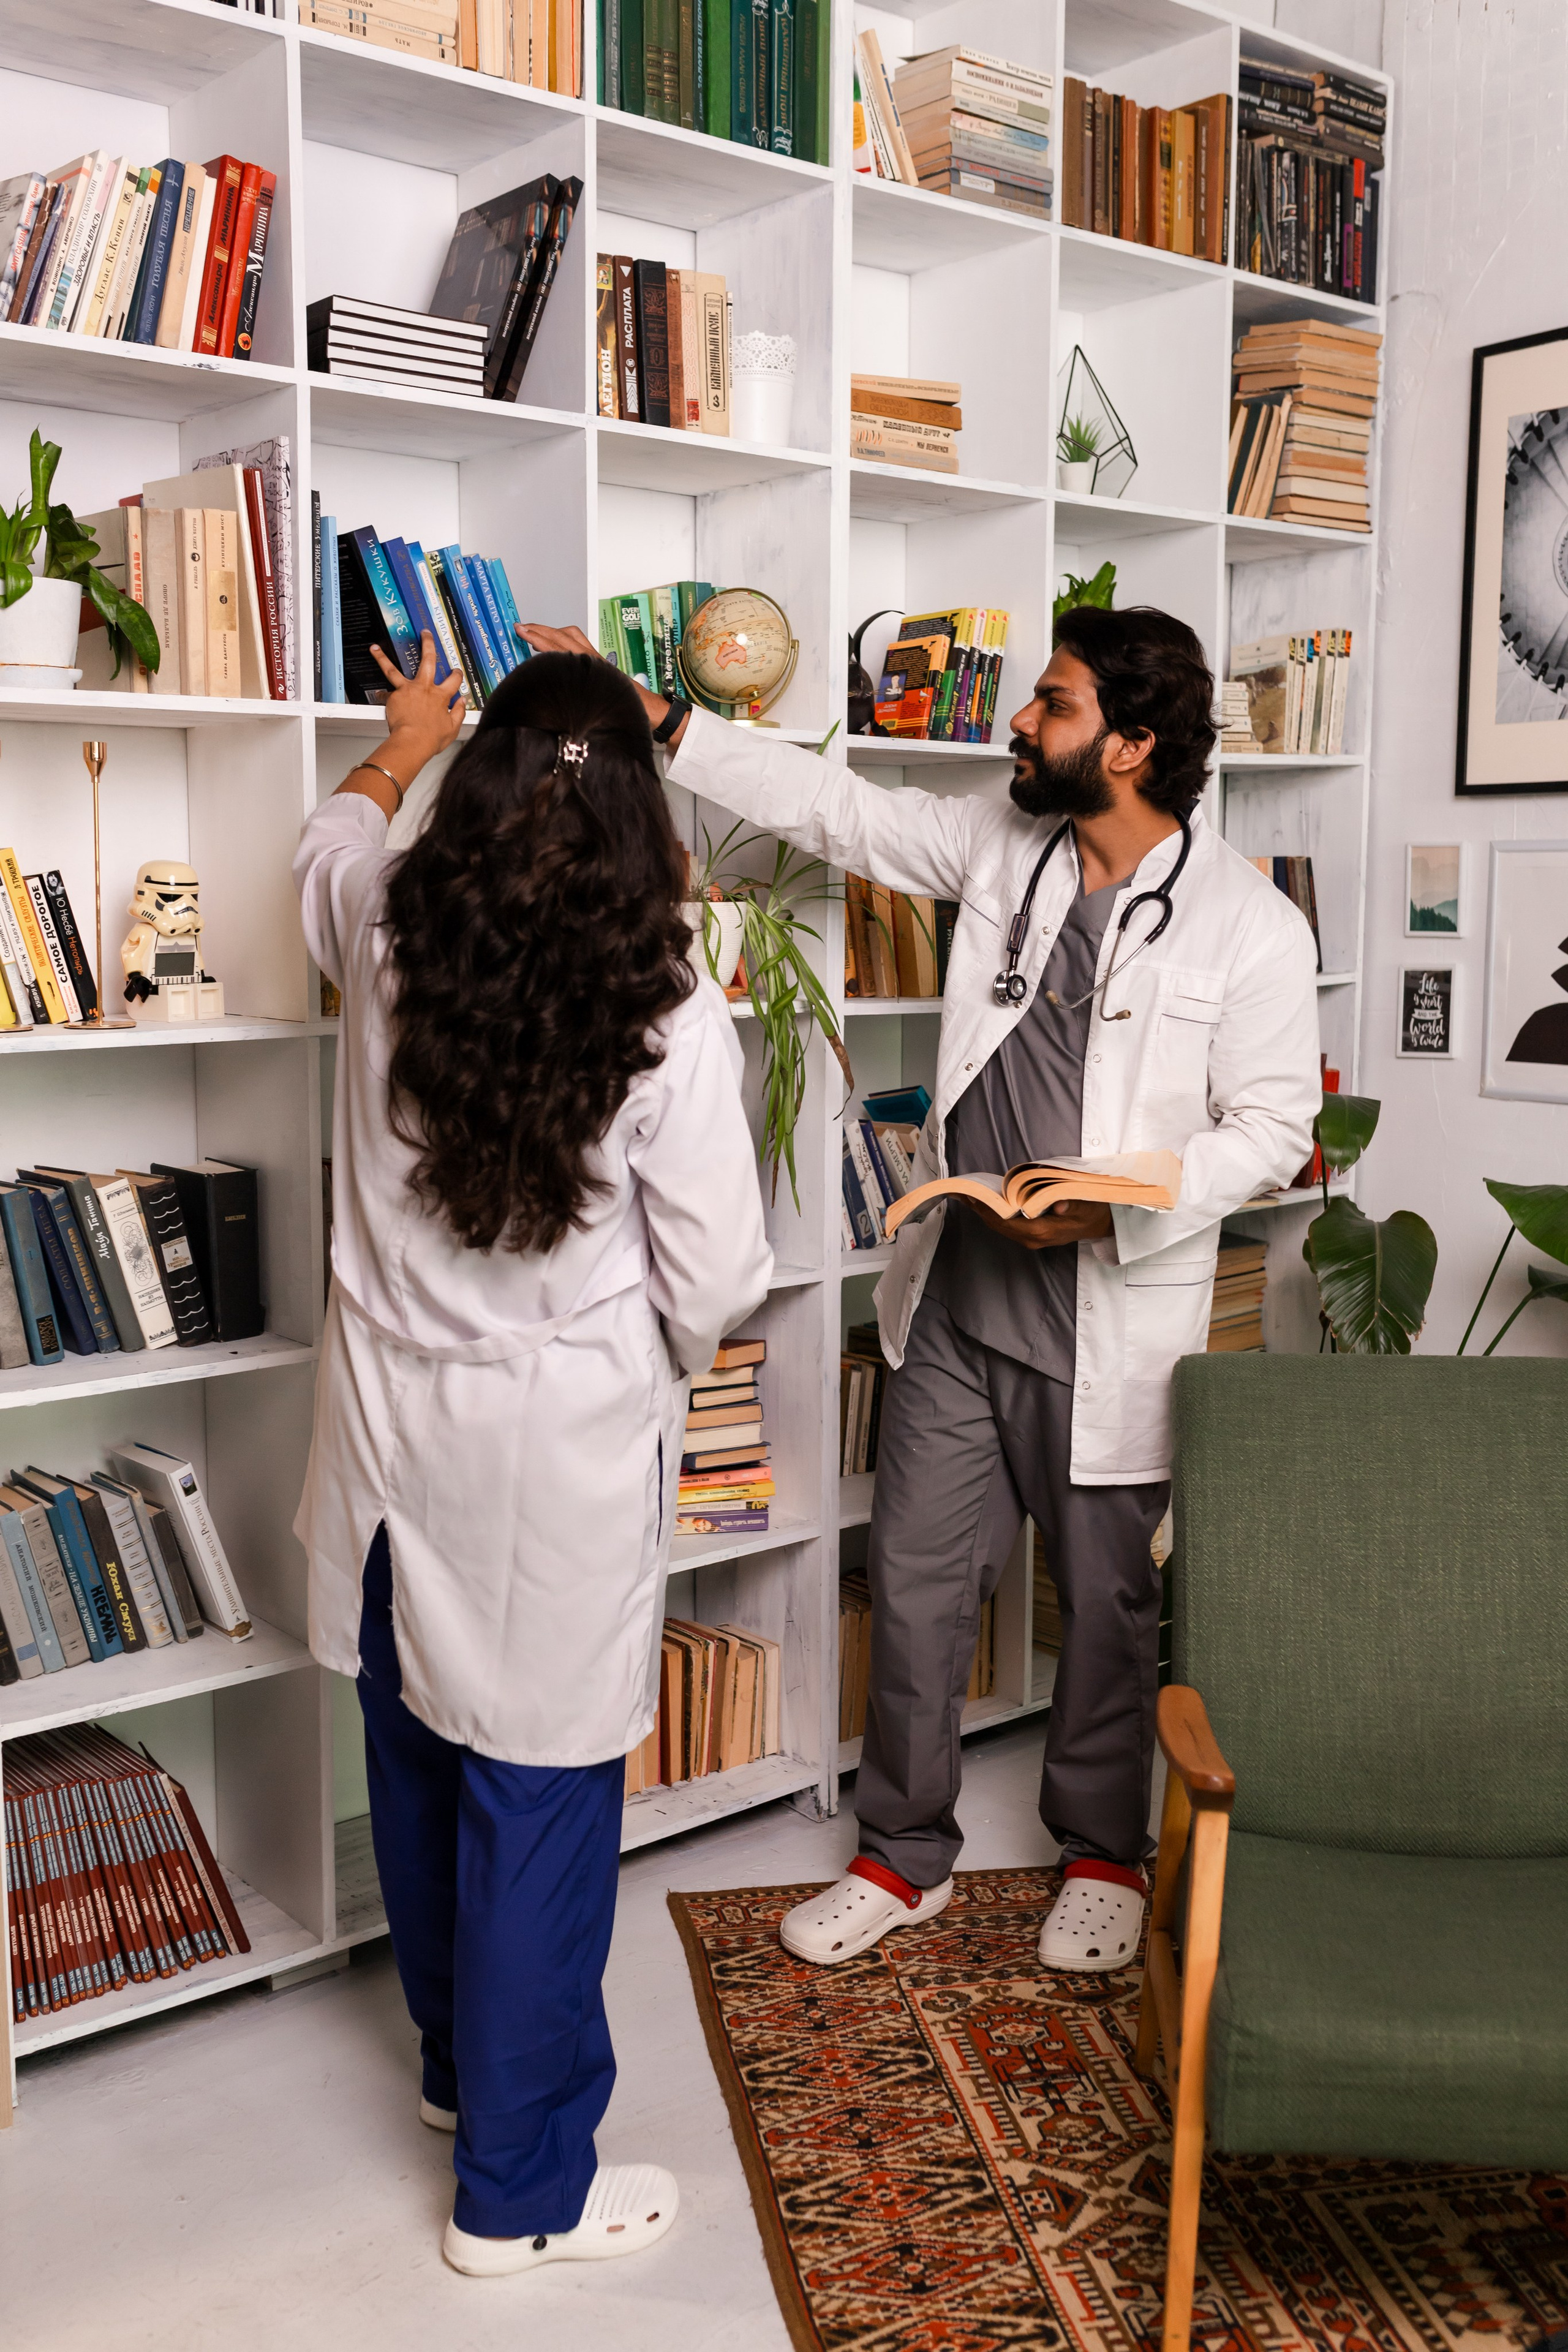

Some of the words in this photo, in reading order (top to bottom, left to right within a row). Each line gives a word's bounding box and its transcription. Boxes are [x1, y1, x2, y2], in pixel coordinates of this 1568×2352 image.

[393, 36, 411, 47] МАТЬ
[758, 54, 766, 127] КАМЕННЫЙ
[67, 221, 86, 264] ВЛАДИМИР
[80, 179, 97, 221] СОЛОУХИН
[86, 212, 101, 241] ВЛАСТЬ
[137, 222, 147, 246] ЗОЛОТОЙ
[143, 203, 152, 222] ВЫКУП
[183, 188, 195, 232] КРЕЩЕНИЕ
[62, 216, 74, 246] АВЕРЧЕНКО
[84, 239, 92, 248] И
[150, 240, 166, 288] ГОЛУБАЯ
[159, 198, 173, 238] ПЕСНЯ
[72, 247, 90, 286] ЗДОРОВЬЕ
[206, 262, 224, 324] Александра
[219, 185, 235, 246] МАРИНИНА
[92, 266, 112, 304] Дуглас
[500, 310, 514, 337] выпускной
[509, 293, 518, 311] альбом
[524, 312, 538, 340] выпускной
[533, 295, 543, 313] альбом
[621, 286, 634, 348] РАСПЛАТА
[707, 311, 720, 336] ПОЯС
[600, 347, 614, 416] ЛЕГИОН
[707, 336, 722, 390] КАМЕННЫЙ
[365, 537, 397, 606] КУКУШКИ
[162, 606, 168, 616] ДЕ
[266, 581, 277, 626] РОССИИ
[389, 607, 409, 636] ЗОВ
[432, 605, 448, 636] КНИГА
[466, 591, 478, 616] король
[474, 560, 491, 593] МАРТА
[485, 594, 500, 623] КЕТРО
[500, 640, 511, 657] ТОТ,
[271, 628, 283, 679] ИСТОРИЯ
[474, 617, 498, 669] Сумасшедший
[660, 617, 675, 679] Метелица
[644, 649, 654, 687] MANOLO
[17, 895, 32, 923] СИЛУЭТЫ
[31, 884, 56, 940] ДОРОГОЕ
[56, 896, 66, 908] Ю
[59, 908, 74, 935] Несбё
[26, 924, 47, 968] ПОЛИТИЧЕСКИЕ
[49, 941, 69, 984] САМОЕ
[66, 936, 85, 976] Нетопырь
[1414, 993, 1419, 1005] is
[1420, 995, 1442, 1009] short
[1418, 973, 1439, 995] Life
[1410, 1017, 1445, 1035] World
[1412, 1035, 1417, 1047] is
[884, 1136, 904, 1172] СМЕРТИ
[860, 1214, 871, 1235] 2
[92, 1231, 111, 1261] Майя
[37, 1321, 50, 1348] КАРИМ
[43, 1316, 59, 1349] МУСТАЙ
[192, 1504, 209, 1536] РОССИИ
[205, 1534, 218, 1558] МЕСТА
[15, 1543, 32, 1581] АНАТОЛИЙ
[27, 1585, 48, 1632] МОШКОВСКИЙ
[68, 1570, 77, 1583] НА
[72, 1583, 86, 1608] ЗЕМЛЕ
[213, 1558, 240, 1615] УДИВИТЕЛЬНЫЕ
[105, 1560, 126, 1600] Юхан
[116, 1601, 138, 1642] Смуул
[80, 1608, 97, 1643] УКРАИНЫ
